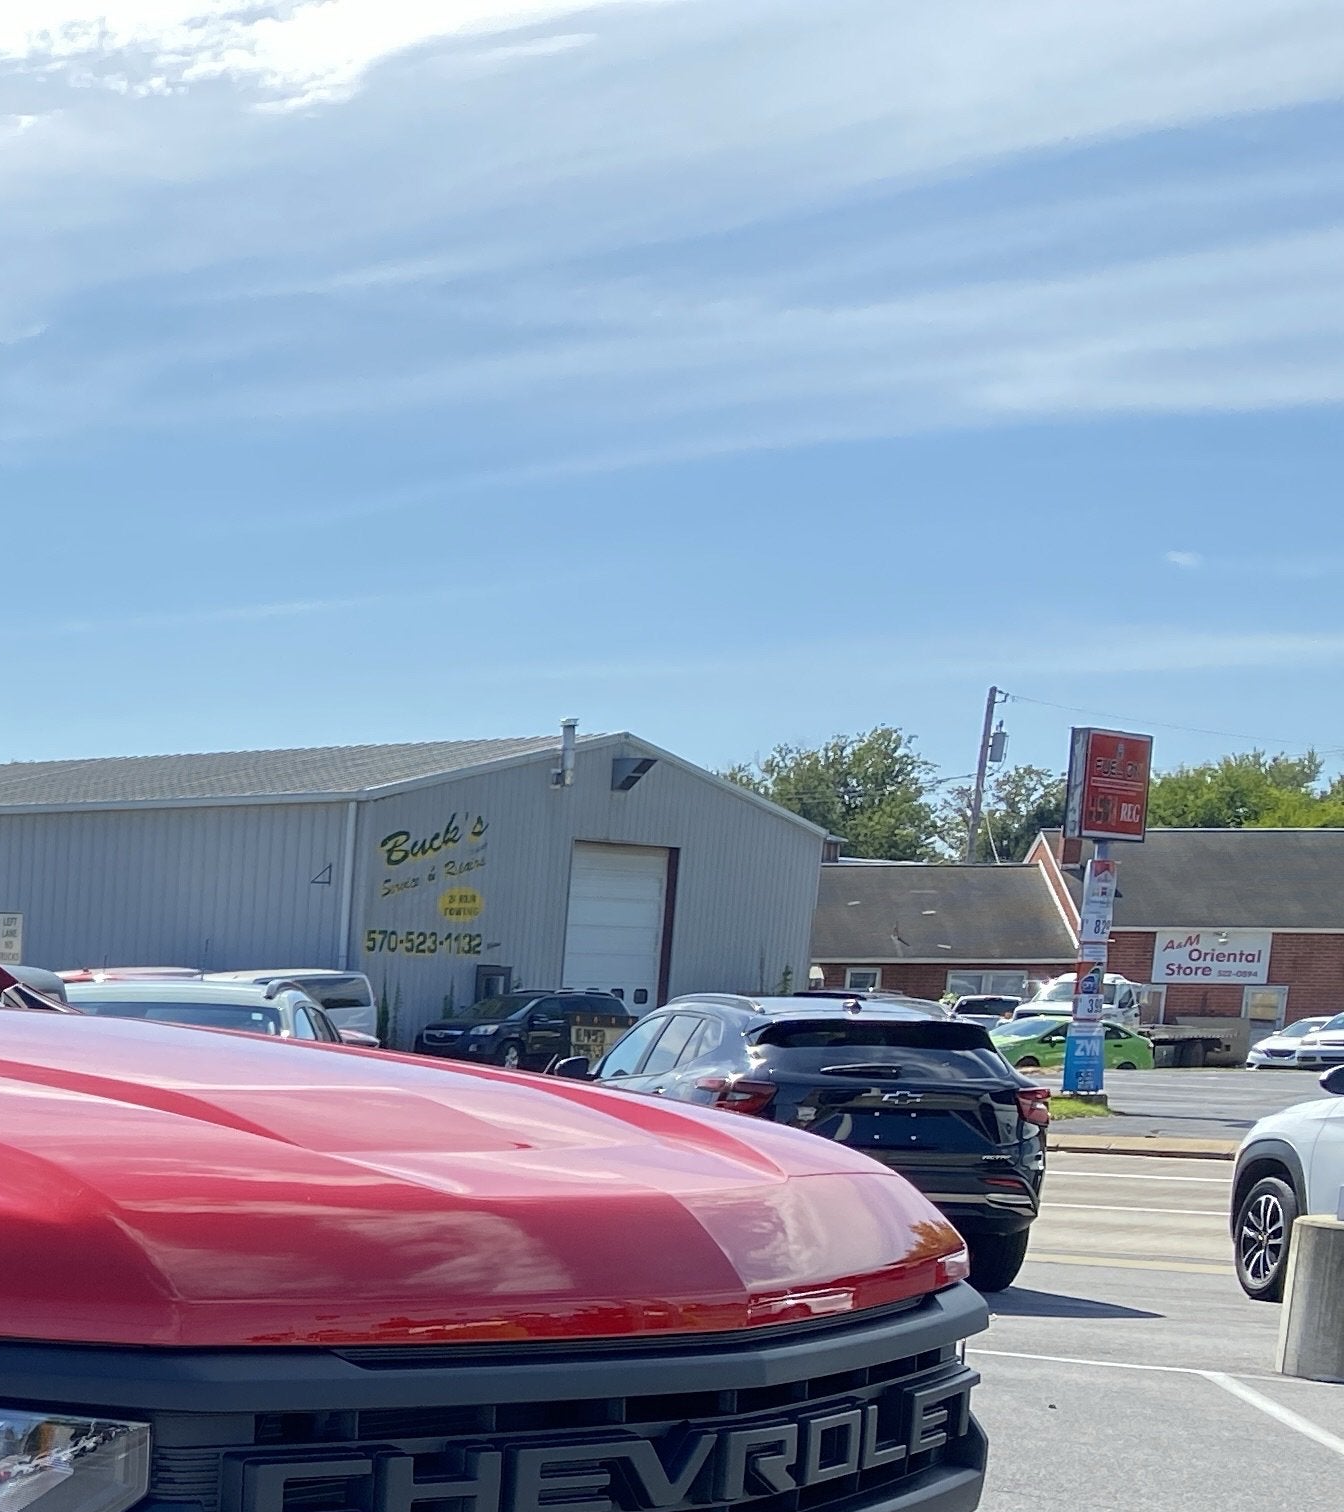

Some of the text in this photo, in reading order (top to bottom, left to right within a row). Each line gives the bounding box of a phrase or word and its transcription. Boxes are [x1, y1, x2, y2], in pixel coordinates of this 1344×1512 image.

[1120, 802, 1141, 823] REG
[380, 811, 490, 866] Buck's
[1163, 933, 1201, 952] A&M
[1188, 948, 1262, 963] Oriental
[1165, 962, 1212, 977] Store
[1074, 1039, 1100, 1057] ZYN
